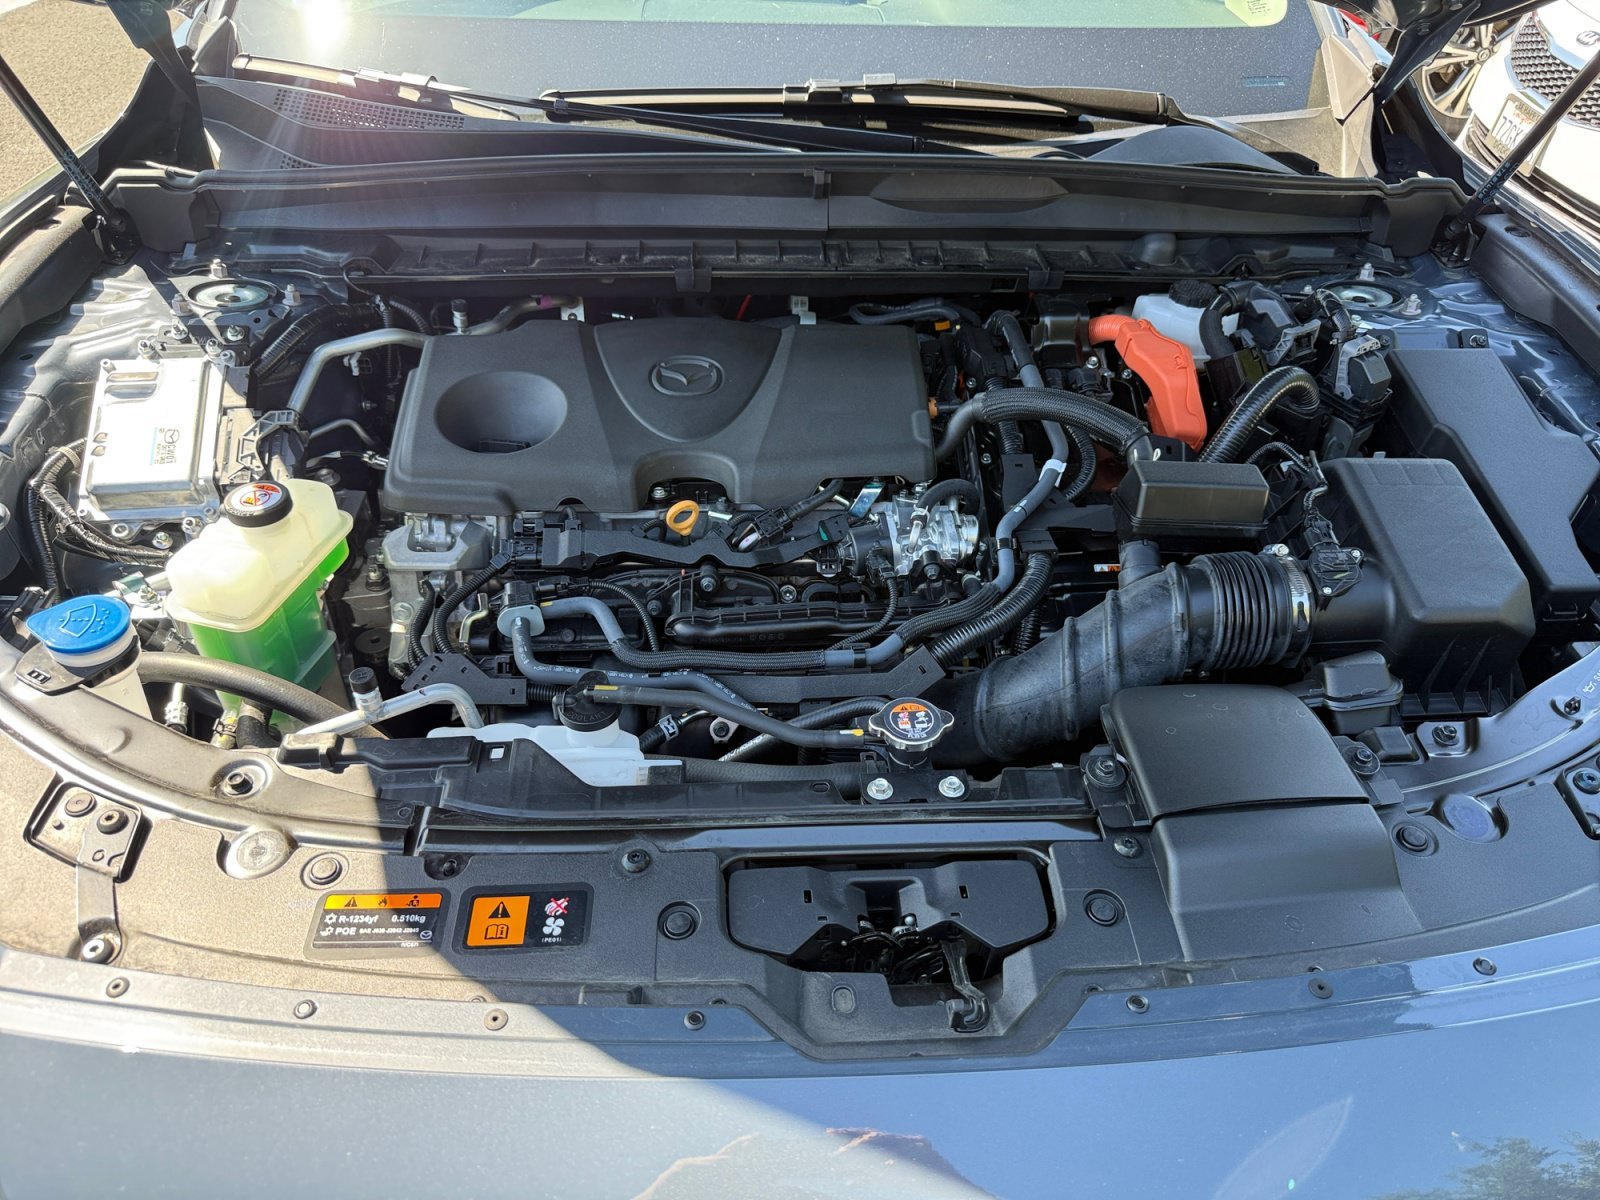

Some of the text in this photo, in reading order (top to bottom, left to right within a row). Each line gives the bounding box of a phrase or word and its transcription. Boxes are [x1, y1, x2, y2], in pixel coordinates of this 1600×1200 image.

[338, 914, 426, 924] R-1234yf 0.510kg
[335, 927, 357, 936] POE
